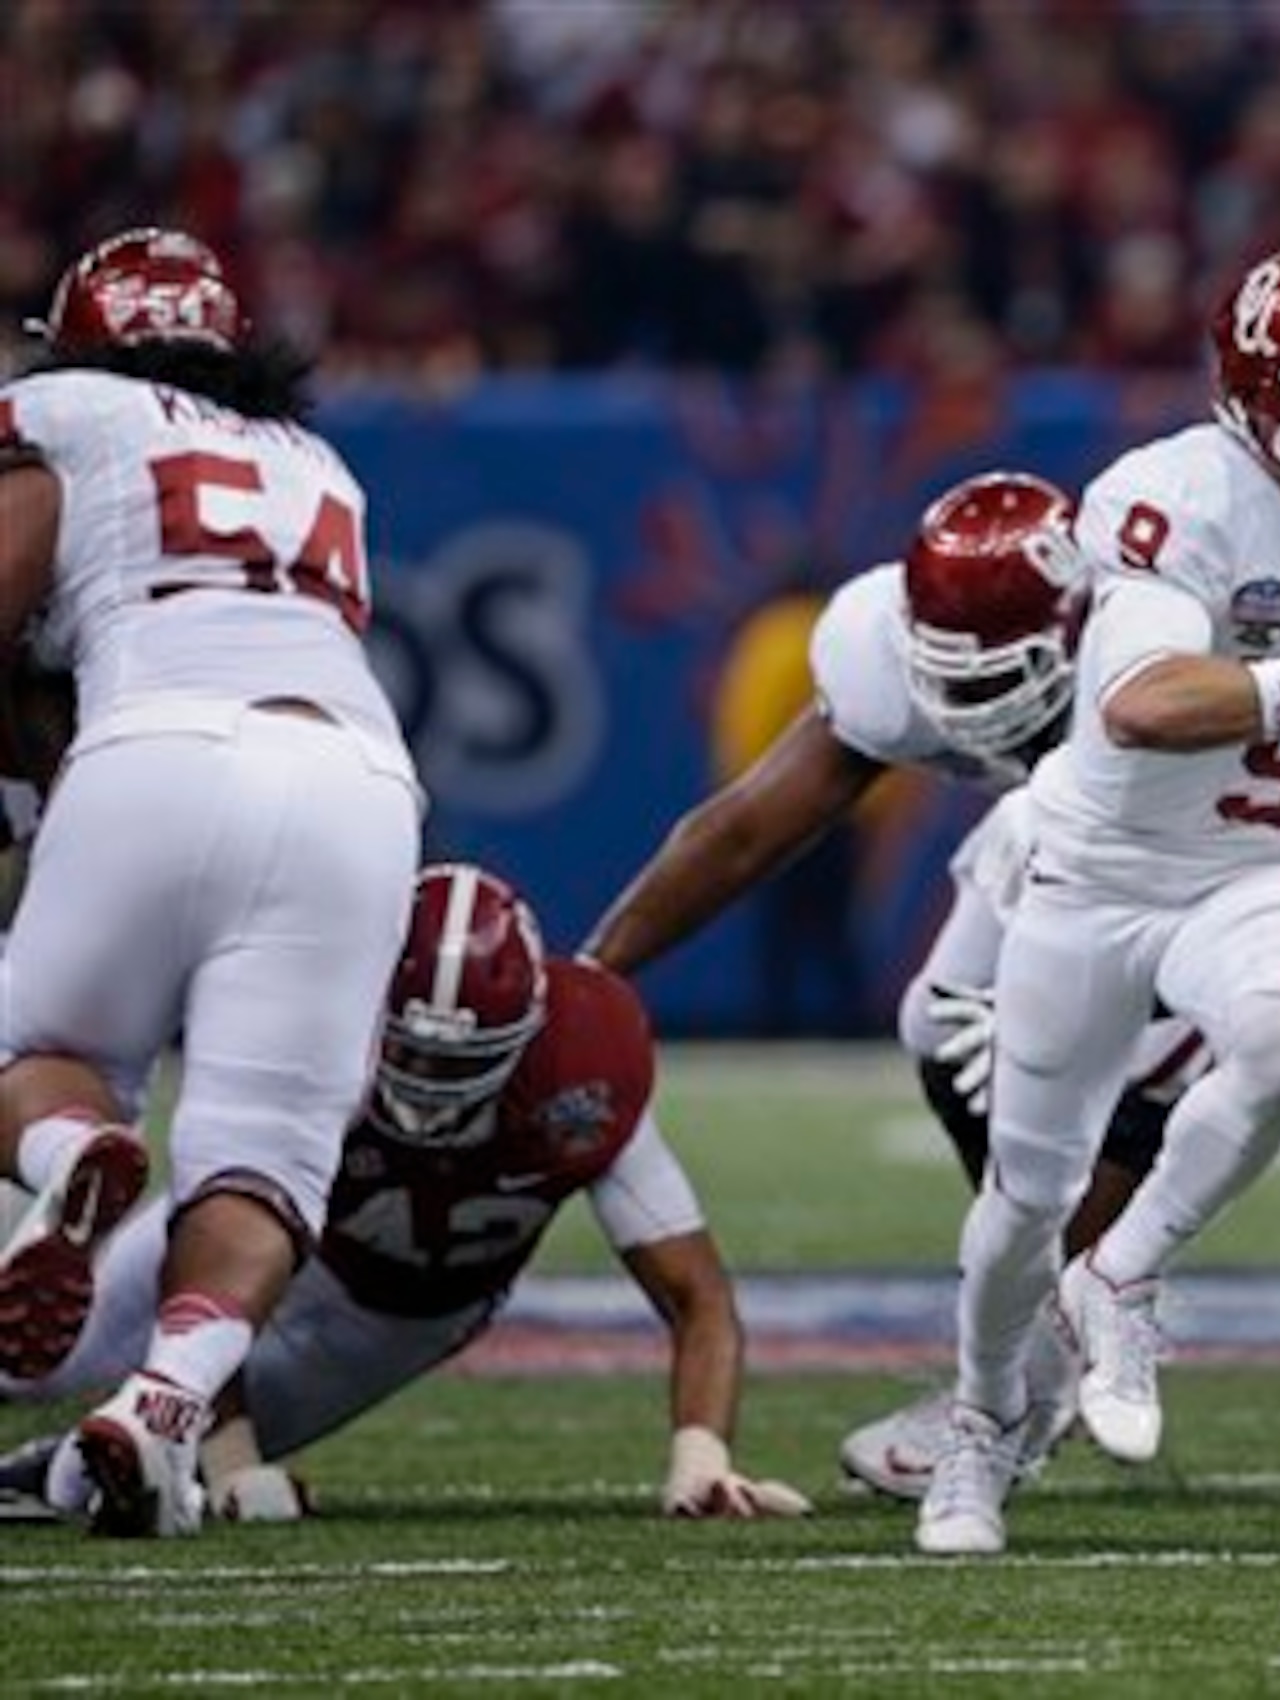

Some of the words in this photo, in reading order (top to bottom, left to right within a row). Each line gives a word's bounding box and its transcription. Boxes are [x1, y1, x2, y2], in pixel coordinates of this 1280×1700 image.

[147, 451, 371, 637] 54
[1118, 502, 1169, 570] 9
[336, 1187, 555, 1268] 42
